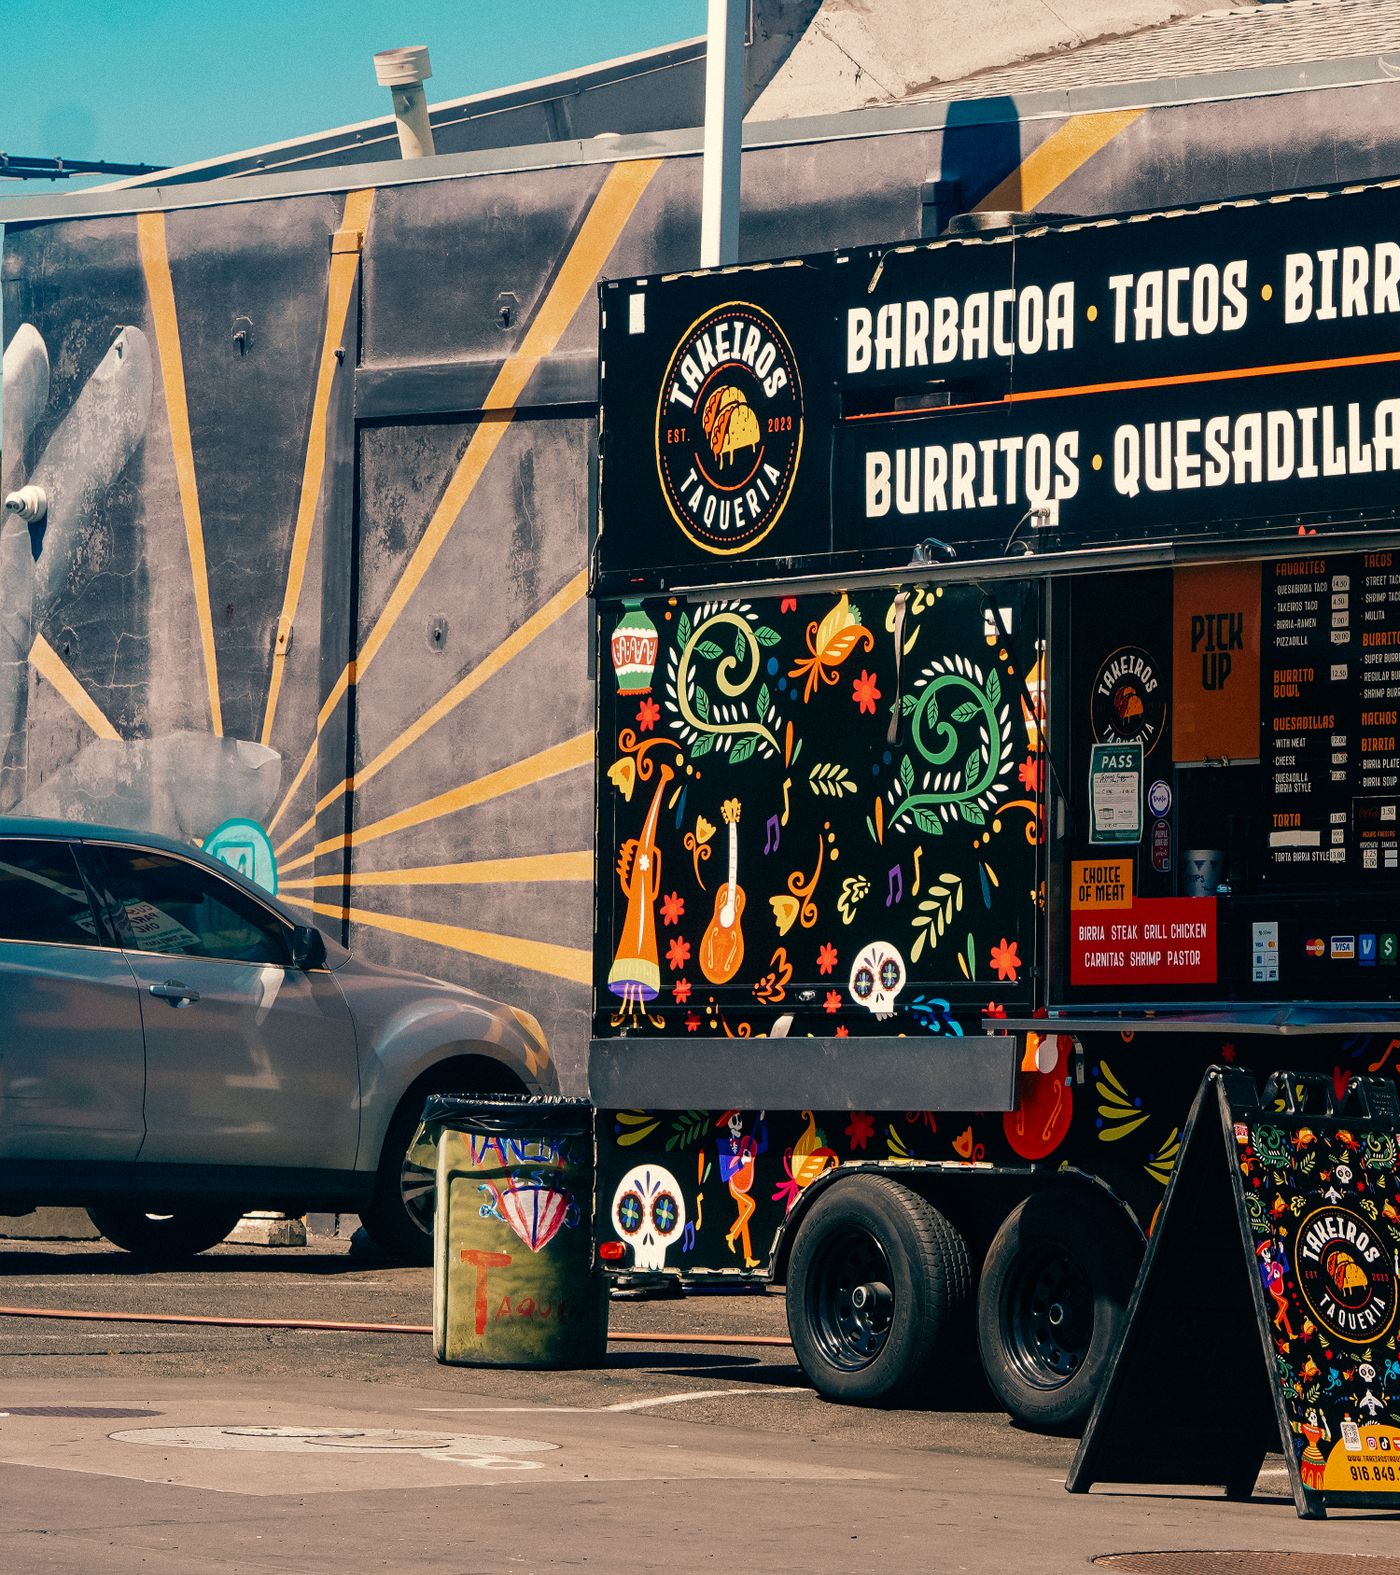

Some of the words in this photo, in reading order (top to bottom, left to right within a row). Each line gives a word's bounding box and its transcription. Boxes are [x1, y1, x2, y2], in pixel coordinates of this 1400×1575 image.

[847, 281, 1075, 374] BARBACOA
[1109, 260, 1248, 343] TACOS
[670, 322, 787, 408] TAKEIROS
[667, 429, 690, 443] EST.
[768, 416, 792, 433] 2023
[865, 431, 1079, 518] BURRITOS
[680, 463, 780, 530] TAQUERIA
[1276, 560, 1326, 576] FAVORITES
[1364, 553, 1392, 568] TACOS
[1314, 582, 1328, 593] TACO
[1366, 576, 1386, 587] STREET
[1365, 593, 1387, 604] SHRIMP
[1277, 602, 1303, 613] TAKEIROS
[1304, 600, 1319, 611] TACO
[1364, 610, 1385, 621] MULITA
[1191, 612, 1243, 652] PICK
[1276, 635, 1308, 647] PIZZADILLA
[1364, 654, 1383, 665] SUPER
[1098, 655, 1158, 697] TAKEIROS
[1202, 652, 1242, 691] UP
[1274, 668, 1314, 683] BURRITO
[1364, 670, 1390, 682] REGULAR
[1274, 684, 1301, 698] BOWL
[1364, 688, 1385, 699] SHRIMP
[1273, 715, 1336, 731] QUESADILLAS
[1362, 710, 1398, 726] NACHOS
[1276, 738, 1291, 749] WITH
[1292, 738, 1307, 748] MEAT
[1361, 736, 1396, 752] BIRRIA
[1102, 754, 1133, 769] PASS
[1276, 756, 1296, 766] CHEESE
[1362, 758, 1382, 770] BIRRIA
[1382, 758, 1400, 769] PLATE
[1275, 772, 1309, 783] QUESADILLA
[1362, 776, 1381, 788] BIRRIA
[1382, 776, 1398, 787] SOUP
[1275, 782, 1293, 794] BIRRIA
[1294, 782, 1312, 793] STYLE
[1382, 808, 1394, 816] 3.50
[1272, 812, 1301, 828] TORTA
[1274, 852, 1292, 862] TORTA
[1292, 852, 1311, 862] BIRRIA
[1312, 851, 1330, 861] STYLE
[1084, 866, 1121, 884] CHOICE
[1079, 885, 1091, 902] OF
[1096, 884, 1125, 902] MEAT
[1079, 926, 1105, 941] BIRRIA
[1112, 925, 1138, 940] STEAK
[1144, 924, 1168, 940] GRILL
[1170, 924, 1207, 939] CHICKEN
[1336, 943, 1350, 951] VISA
[1084, 952, 1125, 968] CARNITAS
[1130, 951, 1161, 967] SHRIMP
[1168, 950, 1201, 966] PASTOR
[1302, 1217, 1380, 1263] TAKEIROS
[1371, 1273, 1390, 1282] 2023
[1320, 1293, 1386, 1330] TAQUERIA
